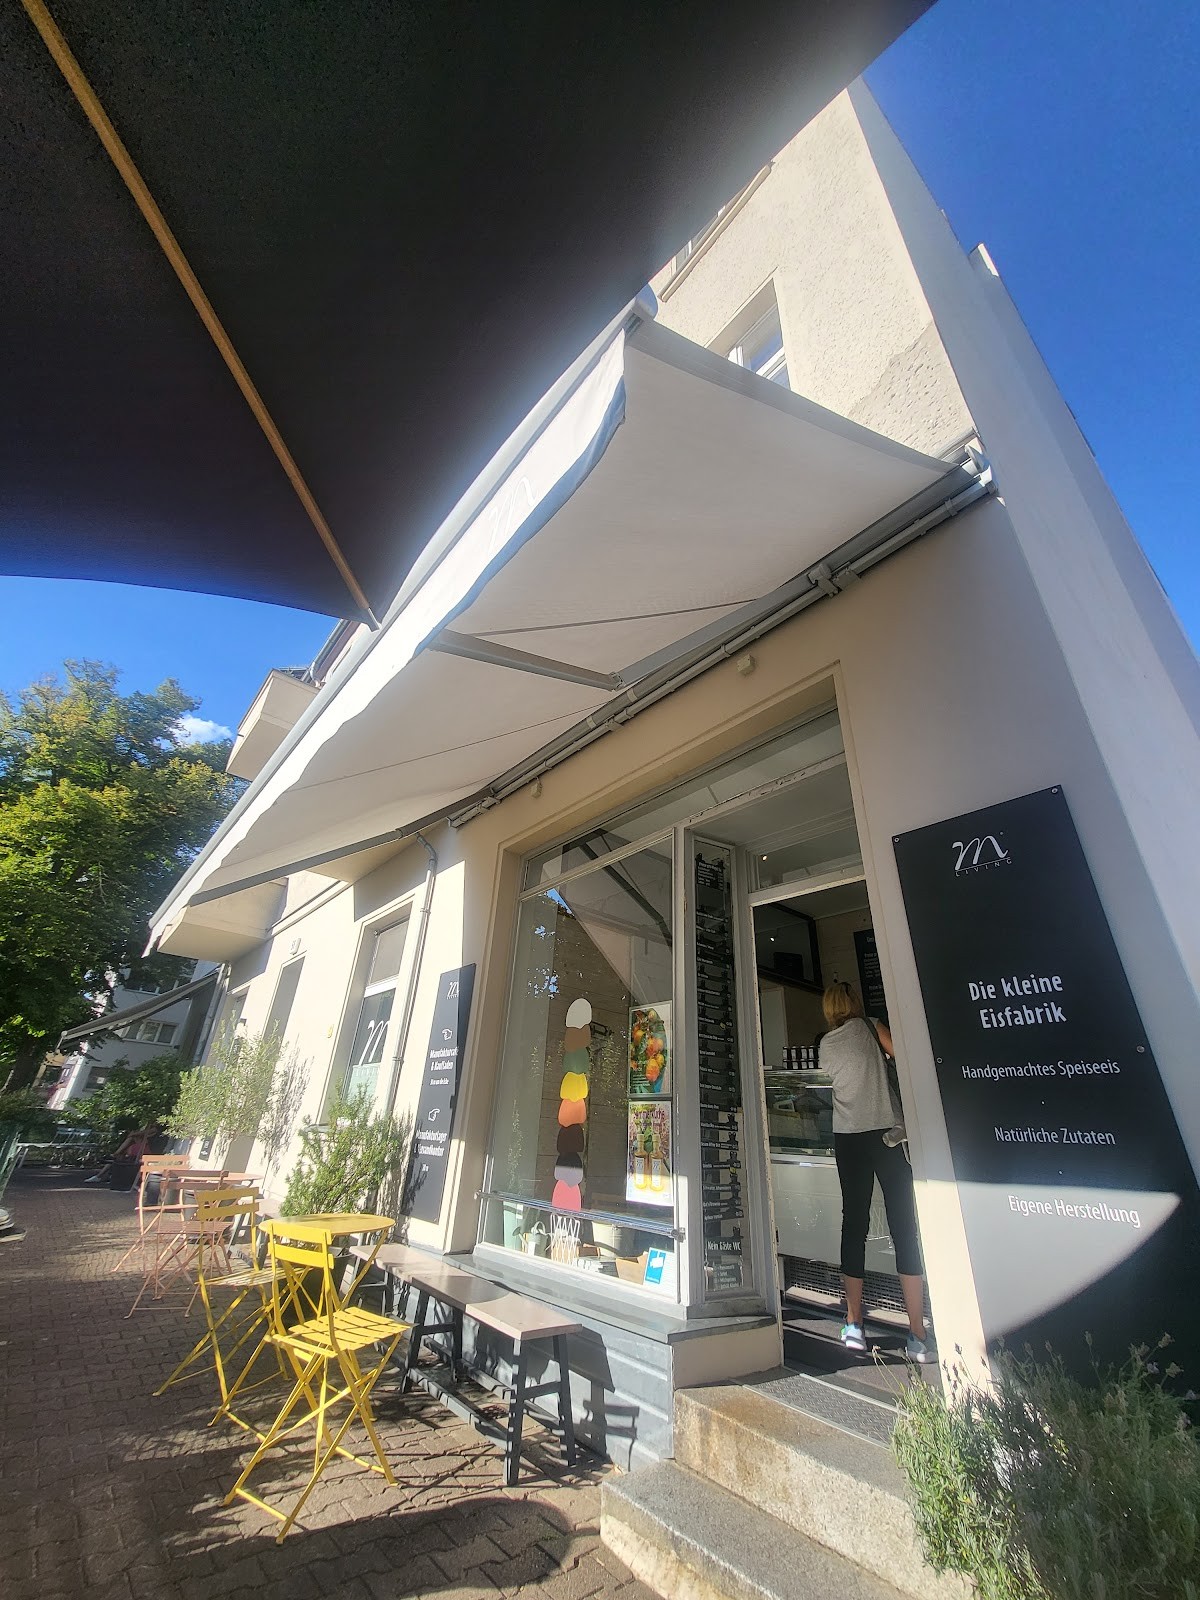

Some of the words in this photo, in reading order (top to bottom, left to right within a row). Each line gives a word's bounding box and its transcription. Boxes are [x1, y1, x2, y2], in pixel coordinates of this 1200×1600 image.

[955, 858, 1012, 877] LIVING
[967, 981, 997, 1002] Die
[1000, 973, 1064, 998] kleine
[979, 1001, 1068, 1029] Eisfabrik
[961, 1061, 1056, 1082] Handgemachtes
[1057, 1058, 1121, 1079] Speiseeis
[994, 1126, 1060, 1144] Natürliche
[1060, 1127, 1116, 1145] Zutaten
[1008, 1195, 1053, 1218] Eigene
[1054, 1198, 1141, 1229] Herstellung
[707, 1240, 719, 1251] Kein
[719, 1241, 732, 1251] Gäste
[732, 1241, 741, 1251] WC
